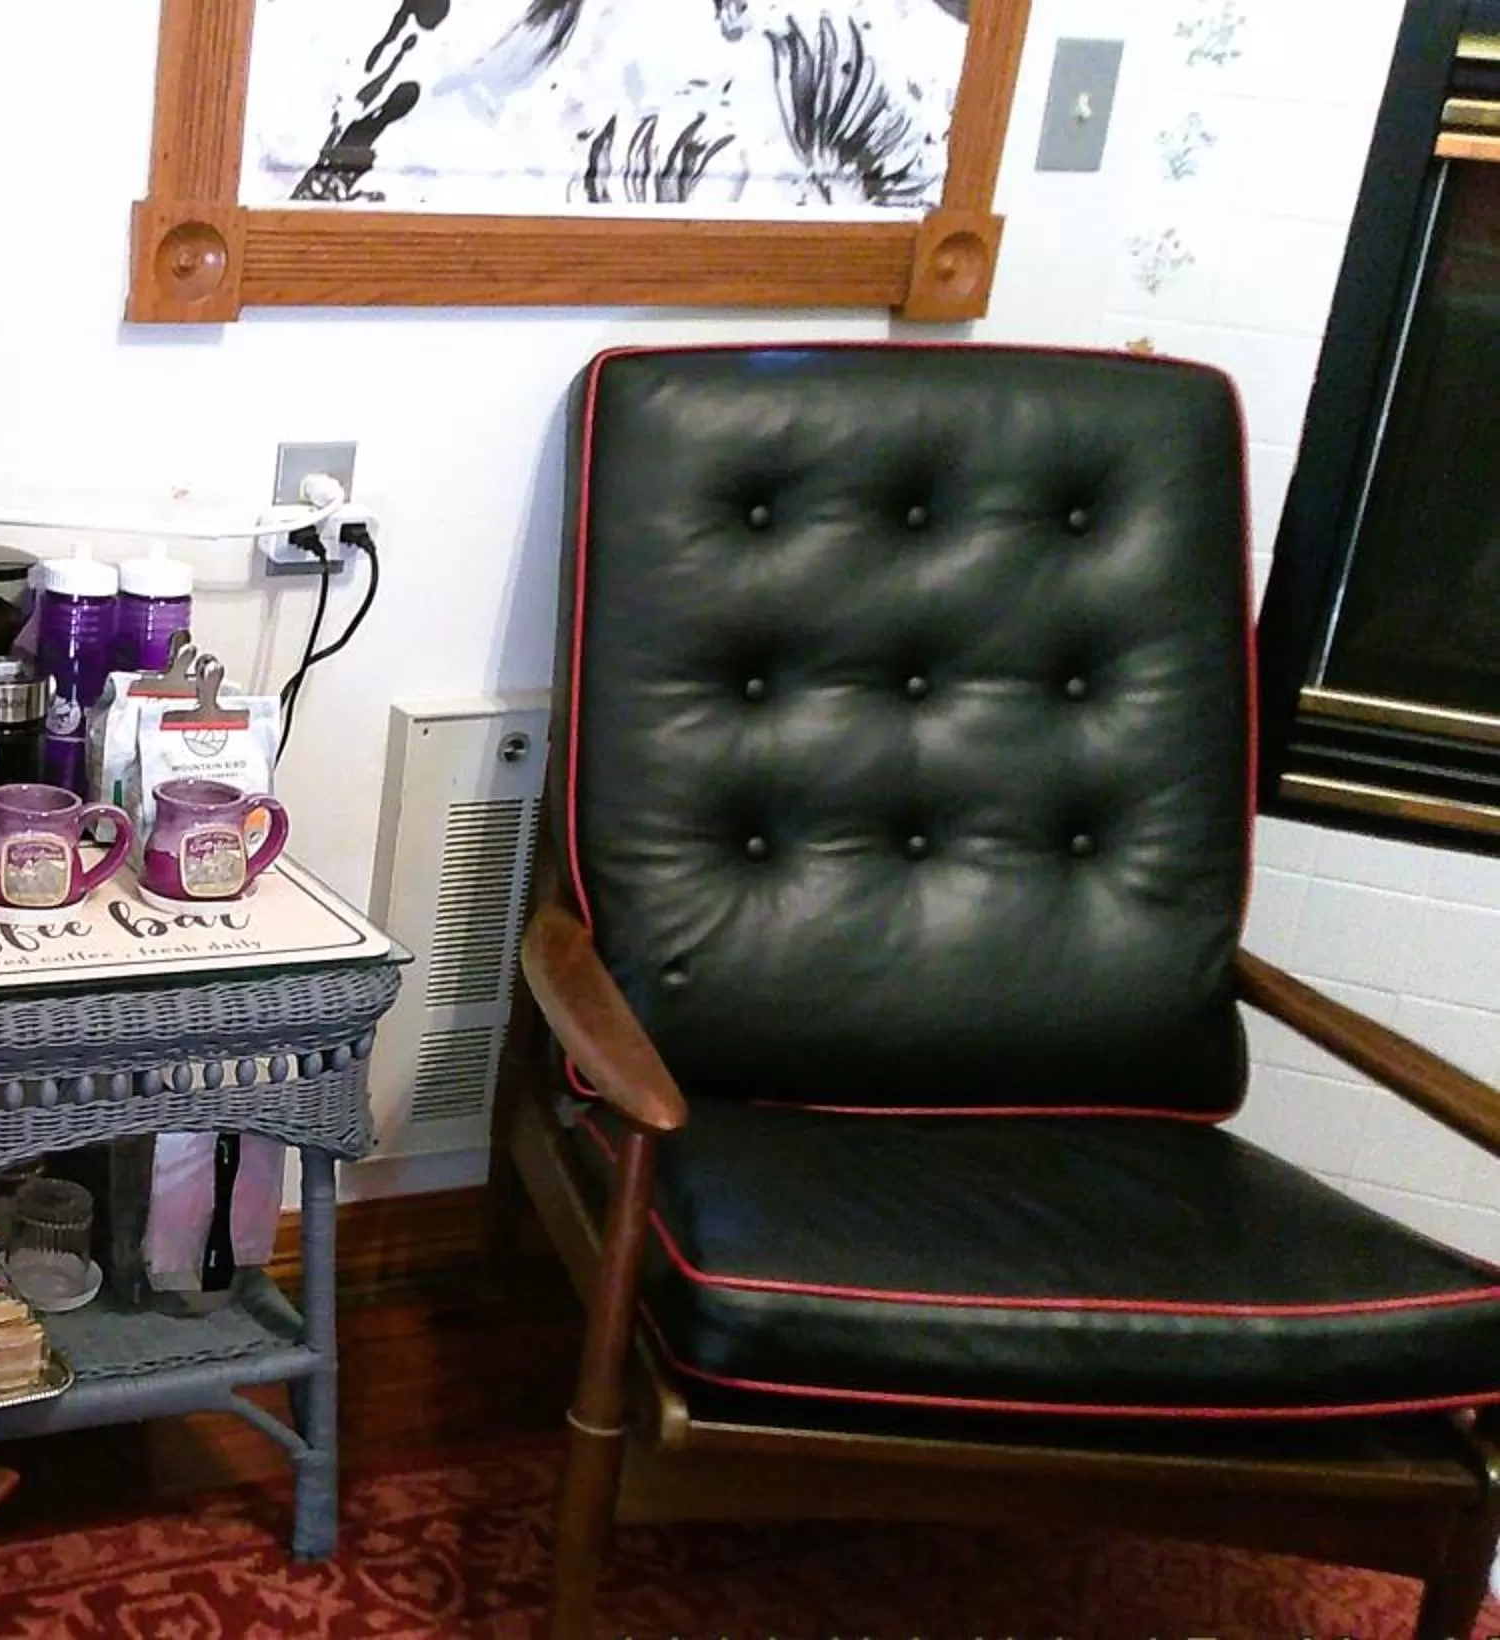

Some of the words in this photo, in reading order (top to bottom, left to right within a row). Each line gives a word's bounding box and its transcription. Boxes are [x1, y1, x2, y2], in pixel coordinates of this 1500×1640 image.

[108, 900, 251, 938] bar
[40, 951, 113, 965] coffee
[139, 943, 199, 956] fresh
[208, 938, 262, 951] daily
